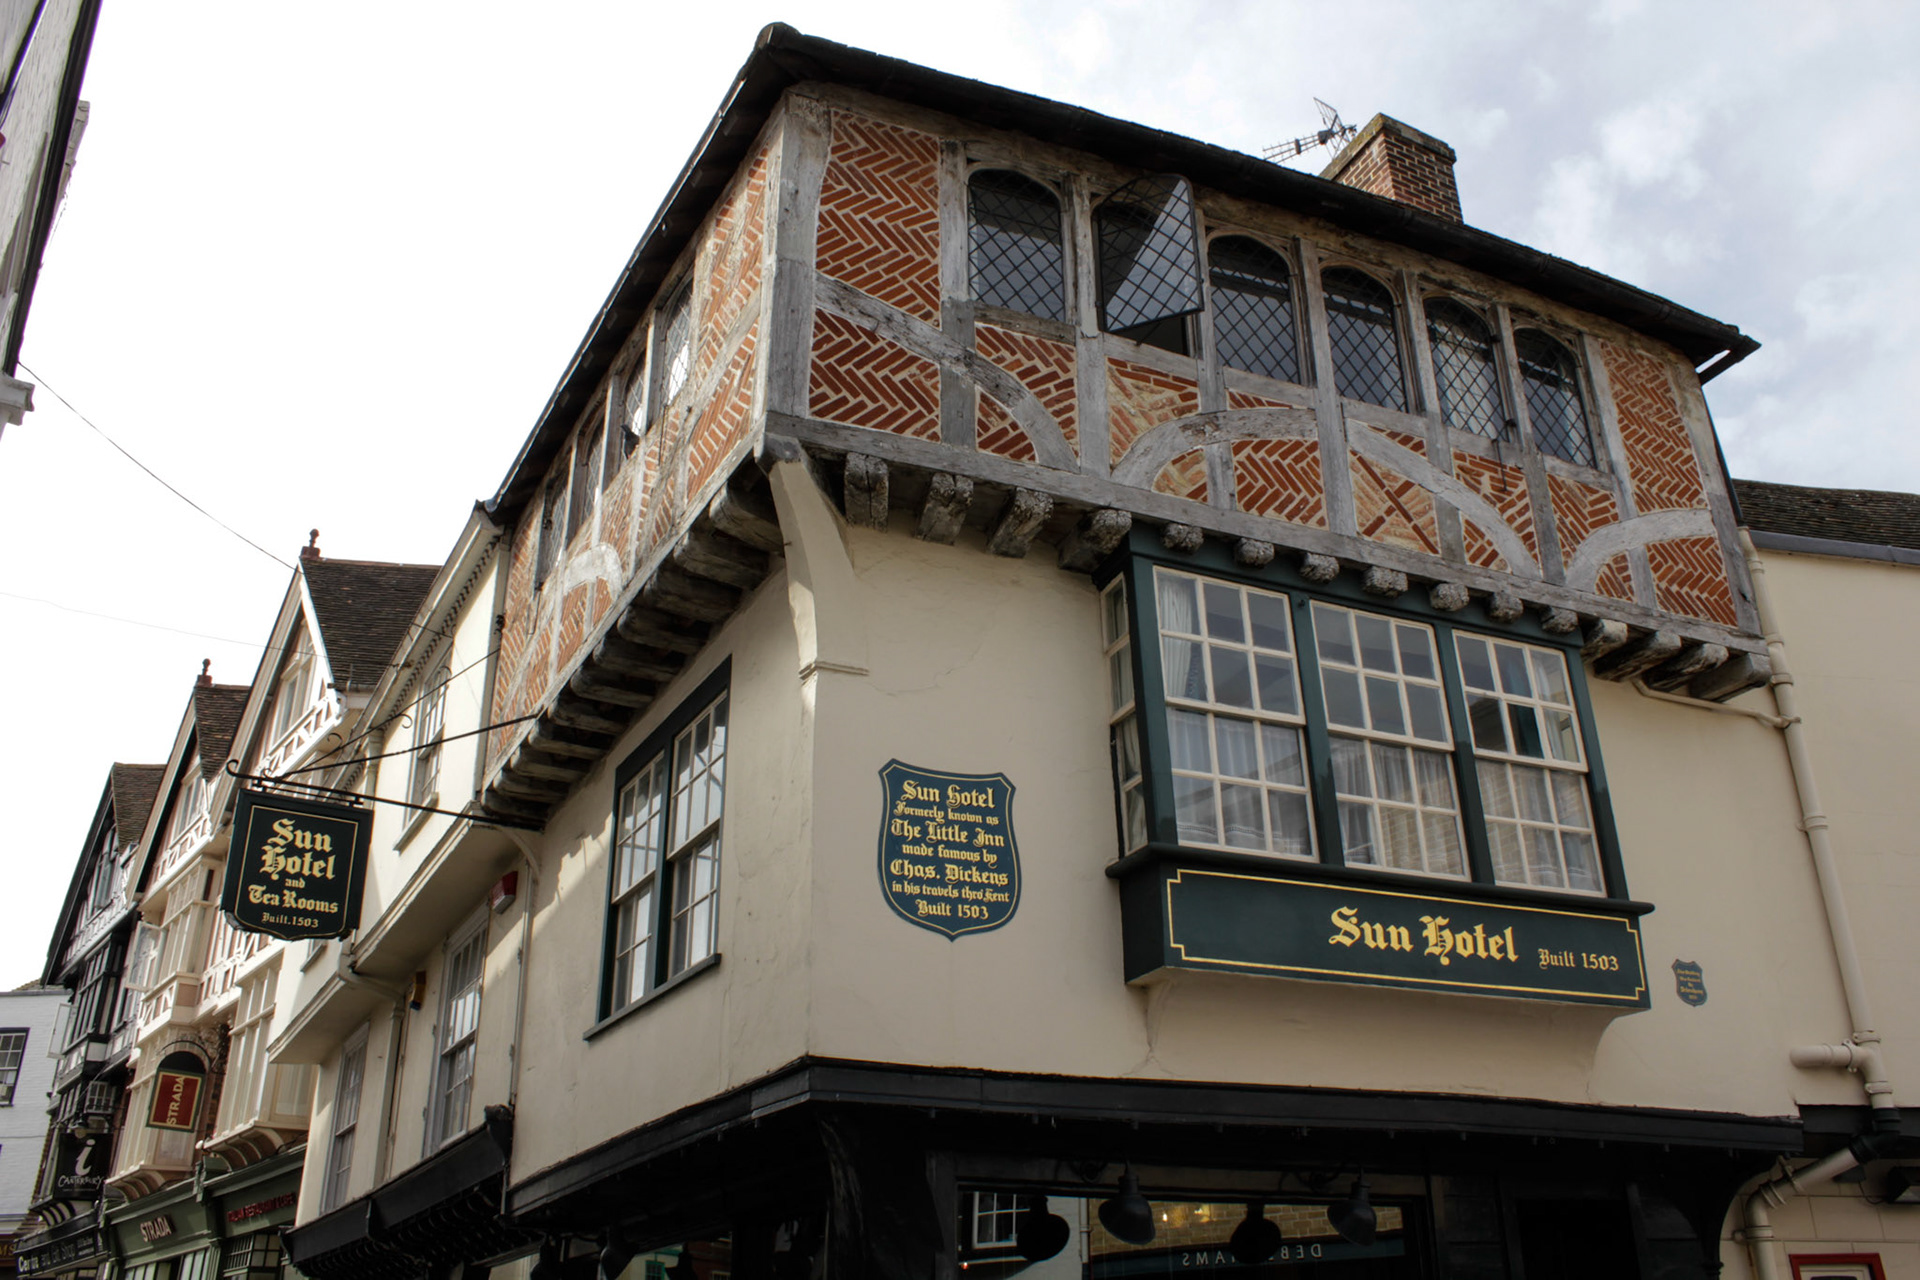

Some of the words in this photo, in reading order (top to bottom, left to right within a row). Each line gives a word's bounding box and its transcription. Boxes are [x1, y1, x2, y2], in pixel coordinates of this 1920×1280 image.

[901, 779, 941, 803] Sun
[946, 784, 996, 809] Hotel
[893, 800, 945, 825] Formerly
[947, 808, 983, 823] known
[986, 815, 999, 826] as
[267, 818, 333, 853] Sun
[891, 818, 922, 842] The
[925, 820, 969, 844] Little
[973, 827, 1005, 848] Inn
[259, 845, 336, 881] Hotel
[902, 843, 935, 857] made
[937, 844, 981, 862] famous
[983, 849, 998, 869] by
[284, 877, 306, 889] and
[890, 858, 941, 880] Chas.
[944, 863, 1009, 887] Dickens
[248, 884, 280, 907] Tea
[282, 889, 339, 914] Rooms
[892, 880, 902, 893] in
[904, 881, 921, 896] his
[922, 884, 959, 899] travels
[983, 888, 1010, 903] Kent
[915, 898, 952, 917] Built
[957, 904, 989, 920] 1503
[1328, 905, 1414, 952] Sun
[1418, 914, 1519, 966] Hotel
[1537, 948, 1576, 970] Built
[1581, 952, 1620, 971] 1503
[166, 1076, 185, 1126] STRADA
[140, 1216, 172, 1242] STRADA
